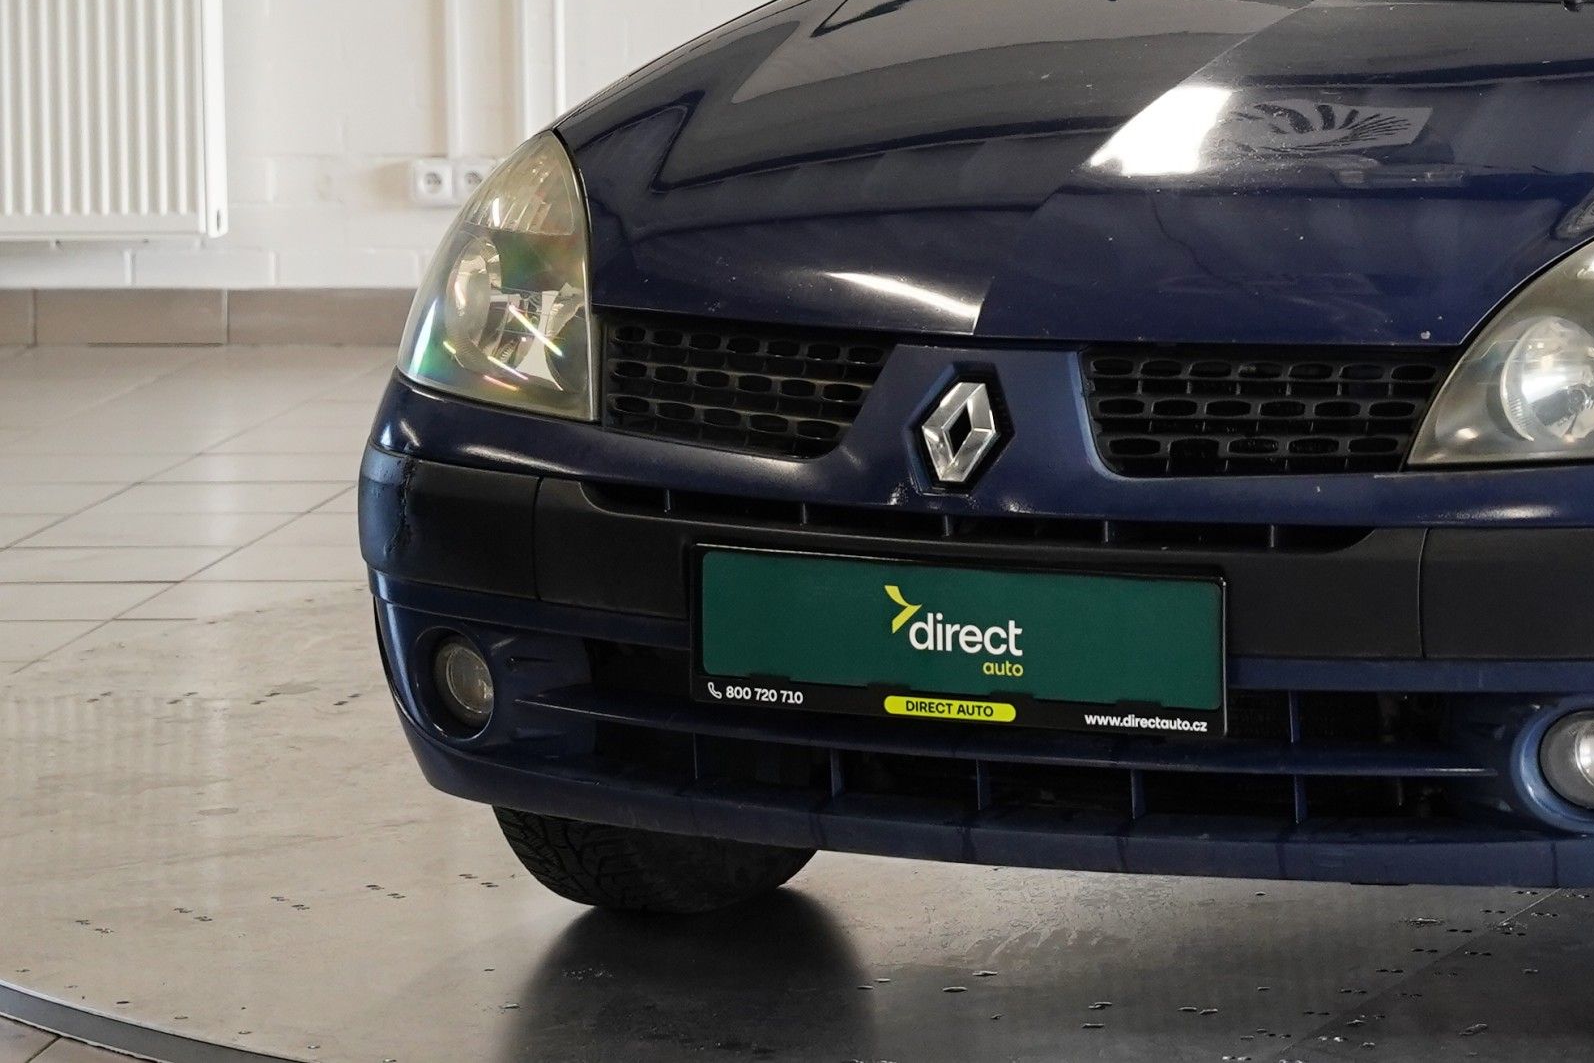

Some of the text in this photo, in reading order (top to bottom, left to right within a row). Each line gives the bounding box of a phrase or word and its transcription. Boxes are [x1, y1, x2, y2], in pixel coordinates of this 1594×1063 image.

[908, 612, 1024, 657] direct
[982, 660, 1025, 677] auto
[725, 685, 804, 705] 800 720 710
[905, 700, 995, 718] DIRECT AUTO
[1084, 713, 1208, 732] www.directauto.cz
